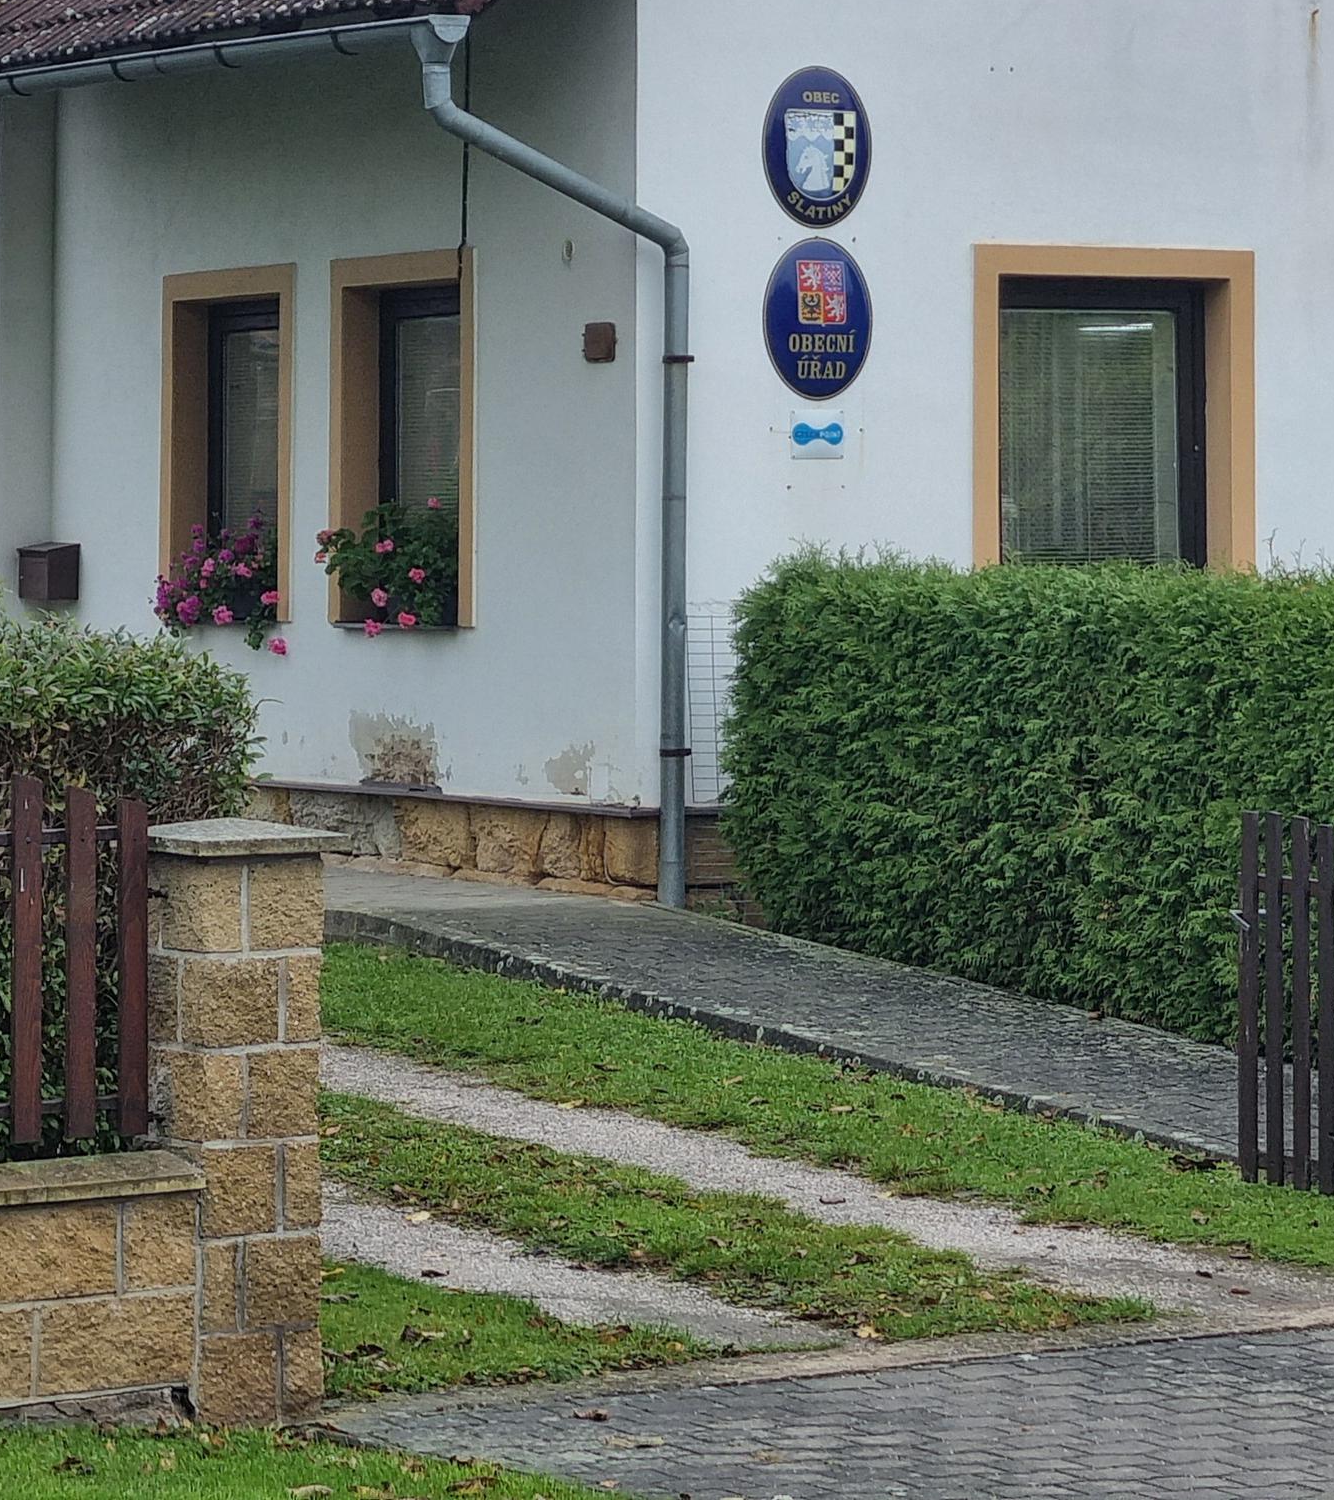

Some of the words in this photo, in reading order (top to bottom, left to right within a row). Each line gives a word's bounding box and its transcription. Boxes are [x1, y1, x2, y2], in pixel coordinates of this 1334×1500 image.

[802, 91, 840, 104] OBEC
[787, 191, 852, 219] SLATINY
[788, 329, 857, 353] OBECNÍ
[797, 355, 847, 379] ÚŘAD
